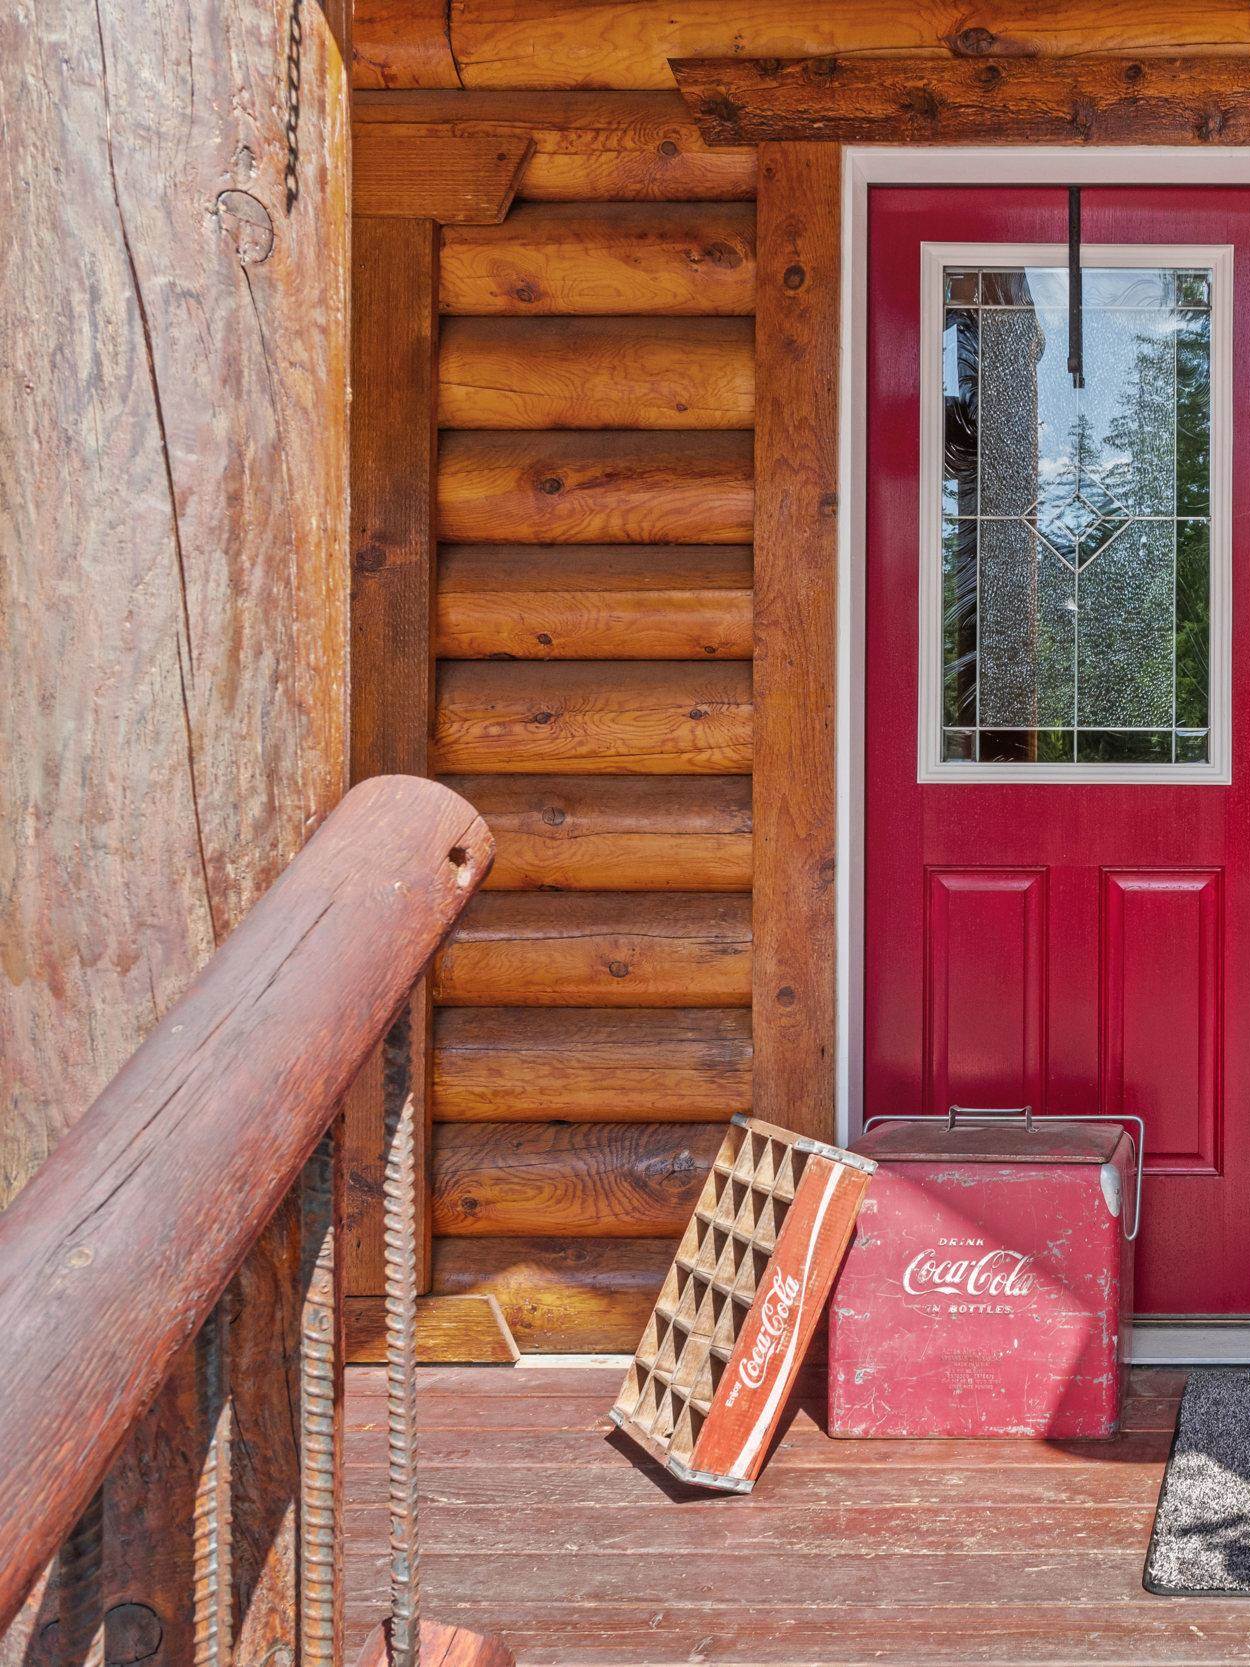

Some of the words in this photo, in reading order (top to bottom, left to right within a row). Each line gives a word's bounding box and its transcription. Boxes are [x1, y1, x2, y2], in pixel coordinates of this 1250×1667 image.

[939, 1238, 984, 1246] DRINK
[902, 1249, 1037, 1296] Coca-Cola
[948, 1304, 1014, 1314] BOTTLES
[725, 1381, 742, 1408] Enjoy
[739, 1266, 799, 1389] Coca-Cola
